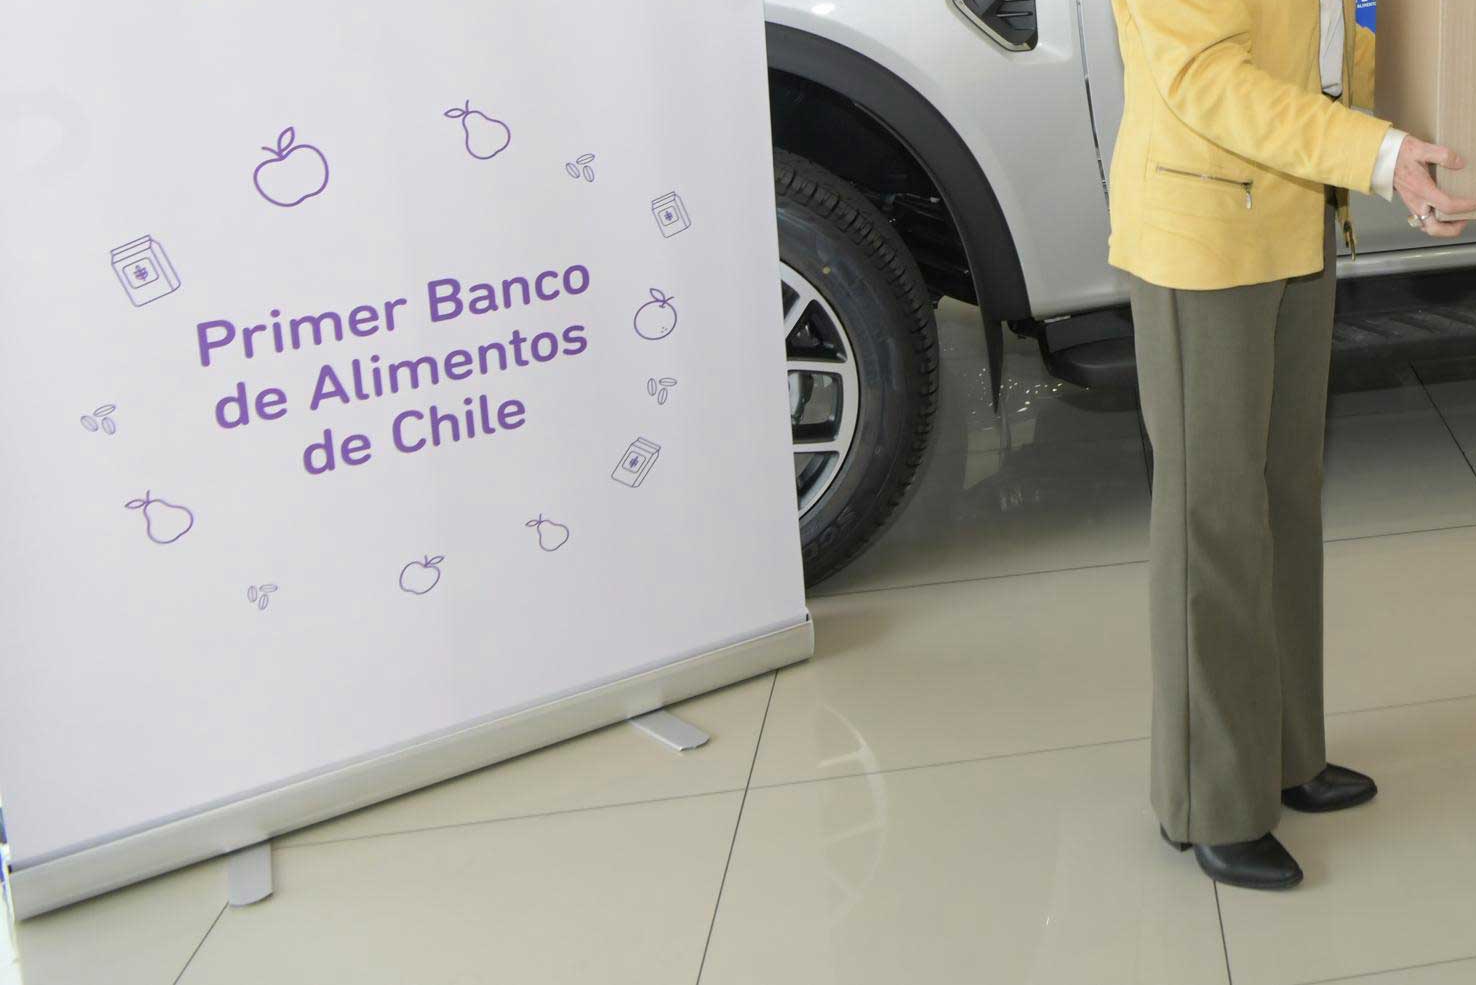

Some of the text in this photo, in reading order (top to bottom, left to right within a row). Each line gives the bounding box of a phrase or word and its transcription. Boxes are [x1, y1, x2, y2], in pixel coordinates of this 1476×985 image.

[197, 264, 590, 367] Primer Banco
[214, 324, 588, 429] de Alimentos
[302, 394, 526, 475] de Chile
